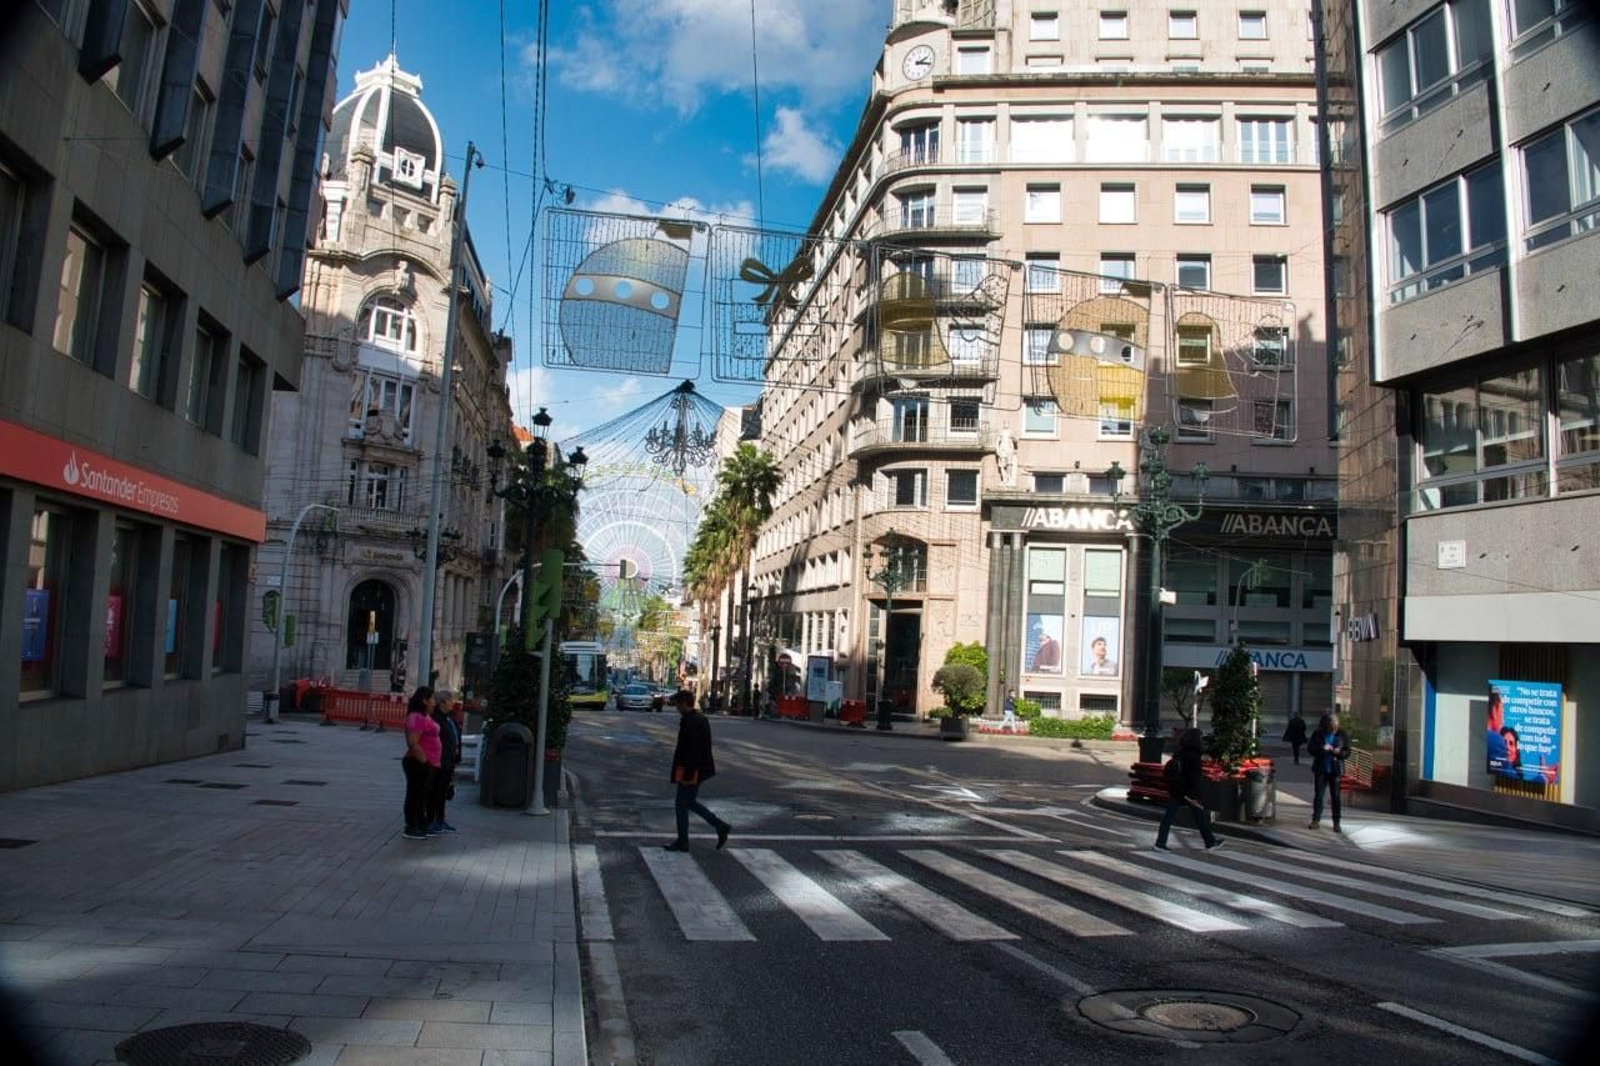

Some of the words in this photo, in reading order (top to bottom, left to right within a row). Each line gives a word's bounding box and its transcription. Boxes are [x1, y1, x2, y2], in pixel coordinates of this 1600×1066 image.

[80, 462, 137, 500] Santander
[138, 481, 180, 514] Empresas
[1348, 613, 1380, 641] BBVA
